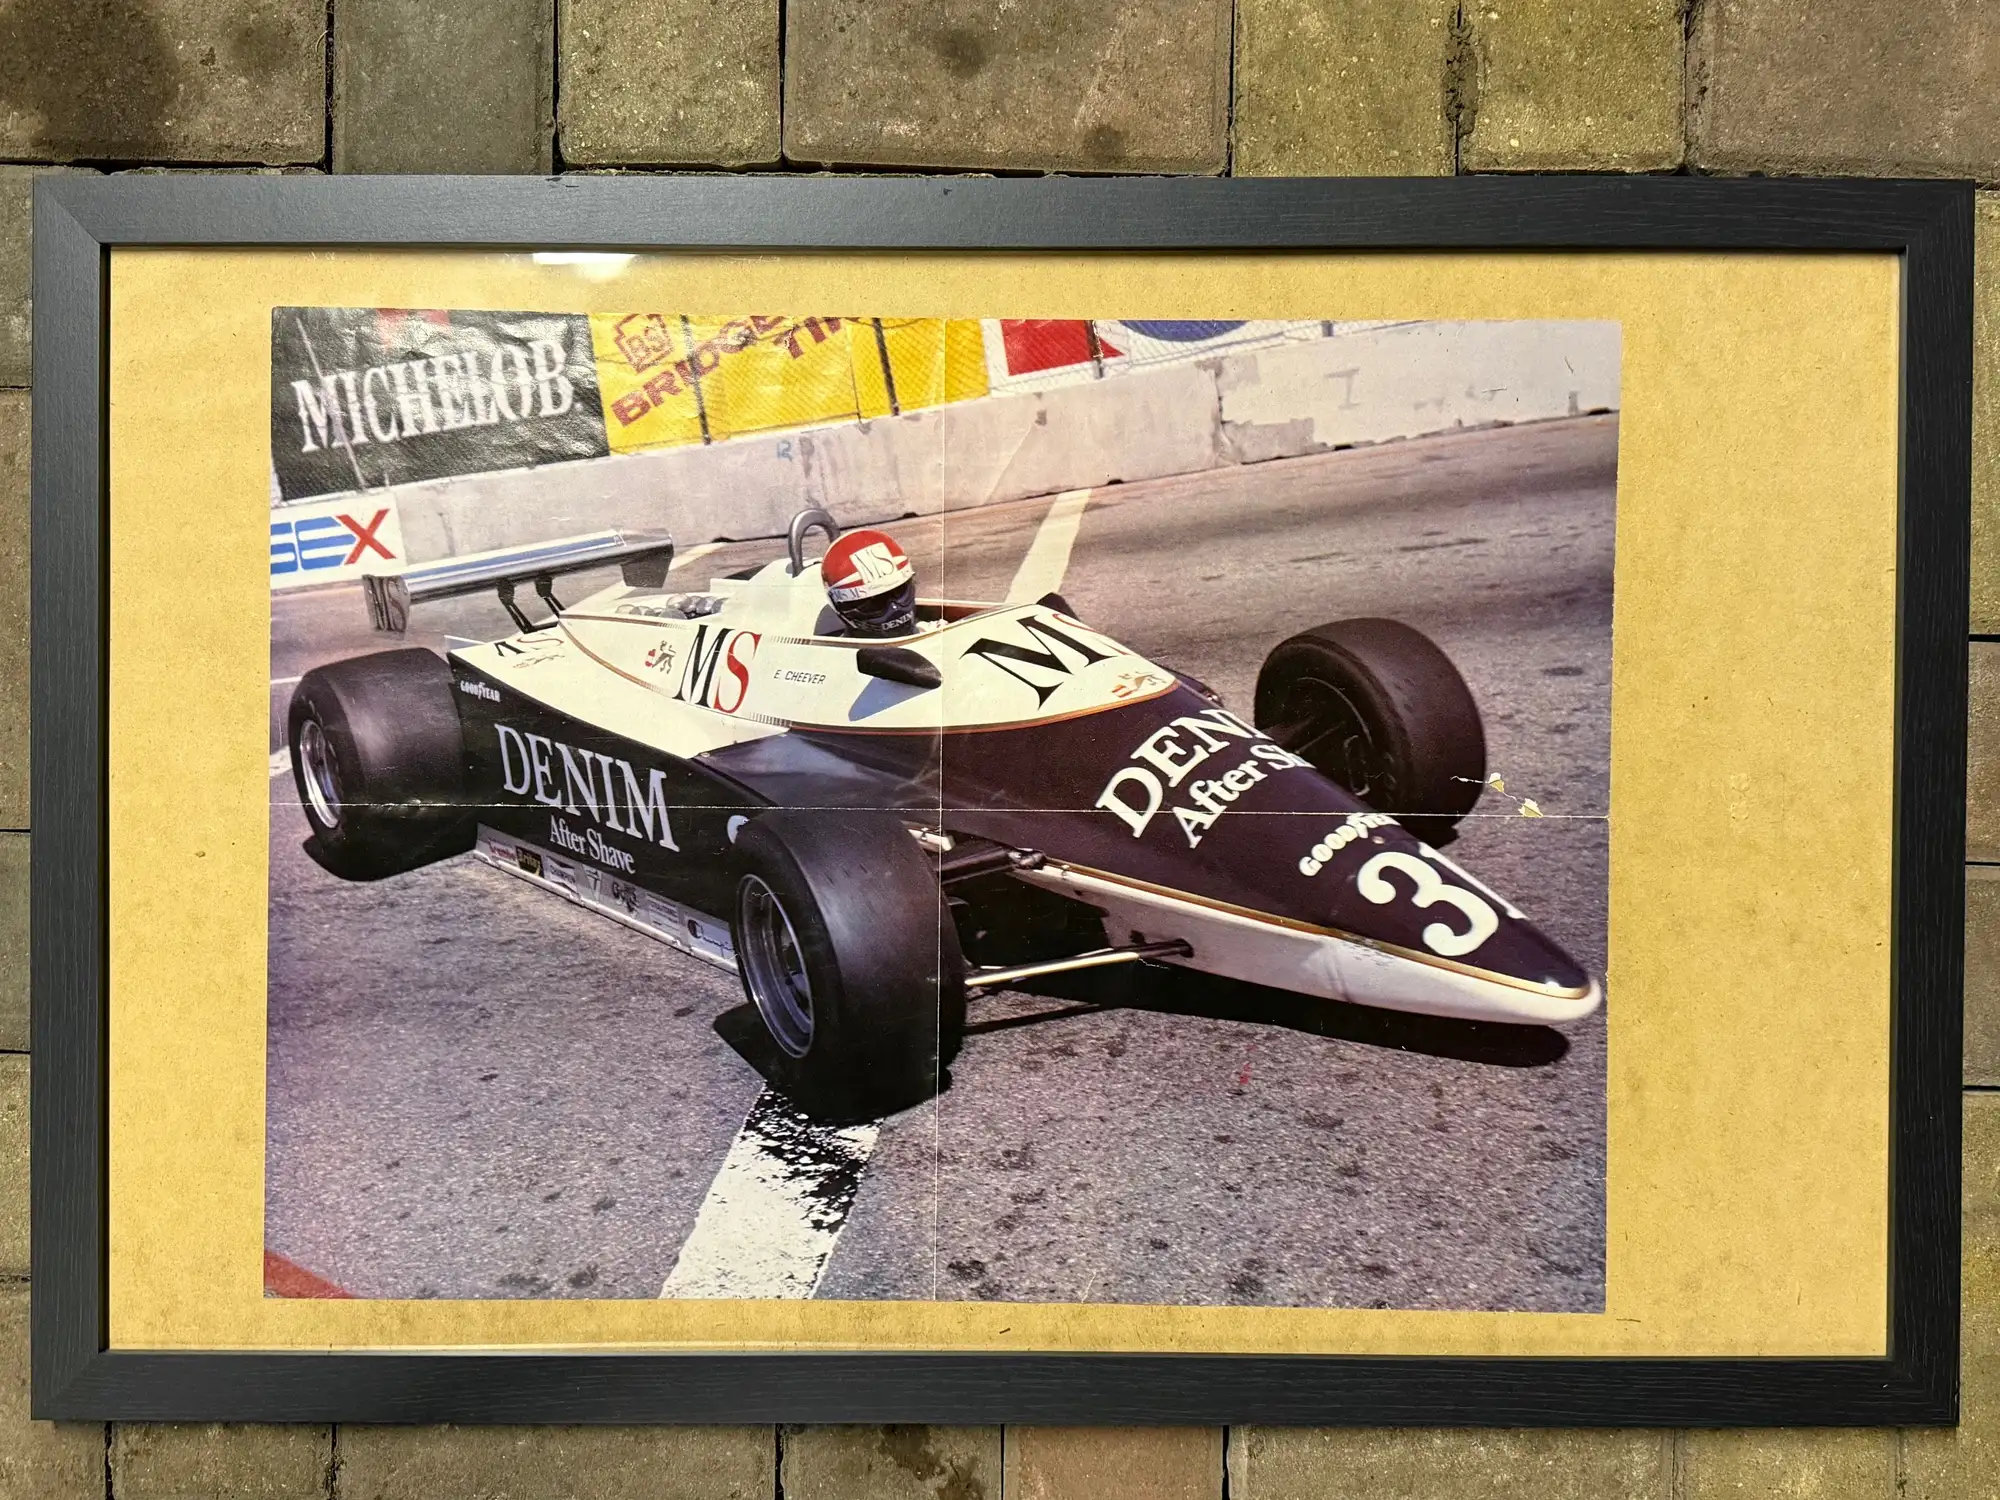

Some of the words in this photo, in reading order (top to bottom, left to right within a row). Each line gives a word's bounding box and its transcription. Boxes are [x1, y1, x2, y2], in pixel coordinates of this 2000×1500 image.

[291, 339, 574, 453] MICHELOB
[460, 680, 501, 703] GOODYEAR
[674, 624, 762, 714] MS
[785, 670, 826, 684] CHEEVER
[494, 723, 680, 852] DENIM
[1172, 760, 1268, 849] After
[550, 814, 586, 855] After
[586, 828, 636, 874] Shave
